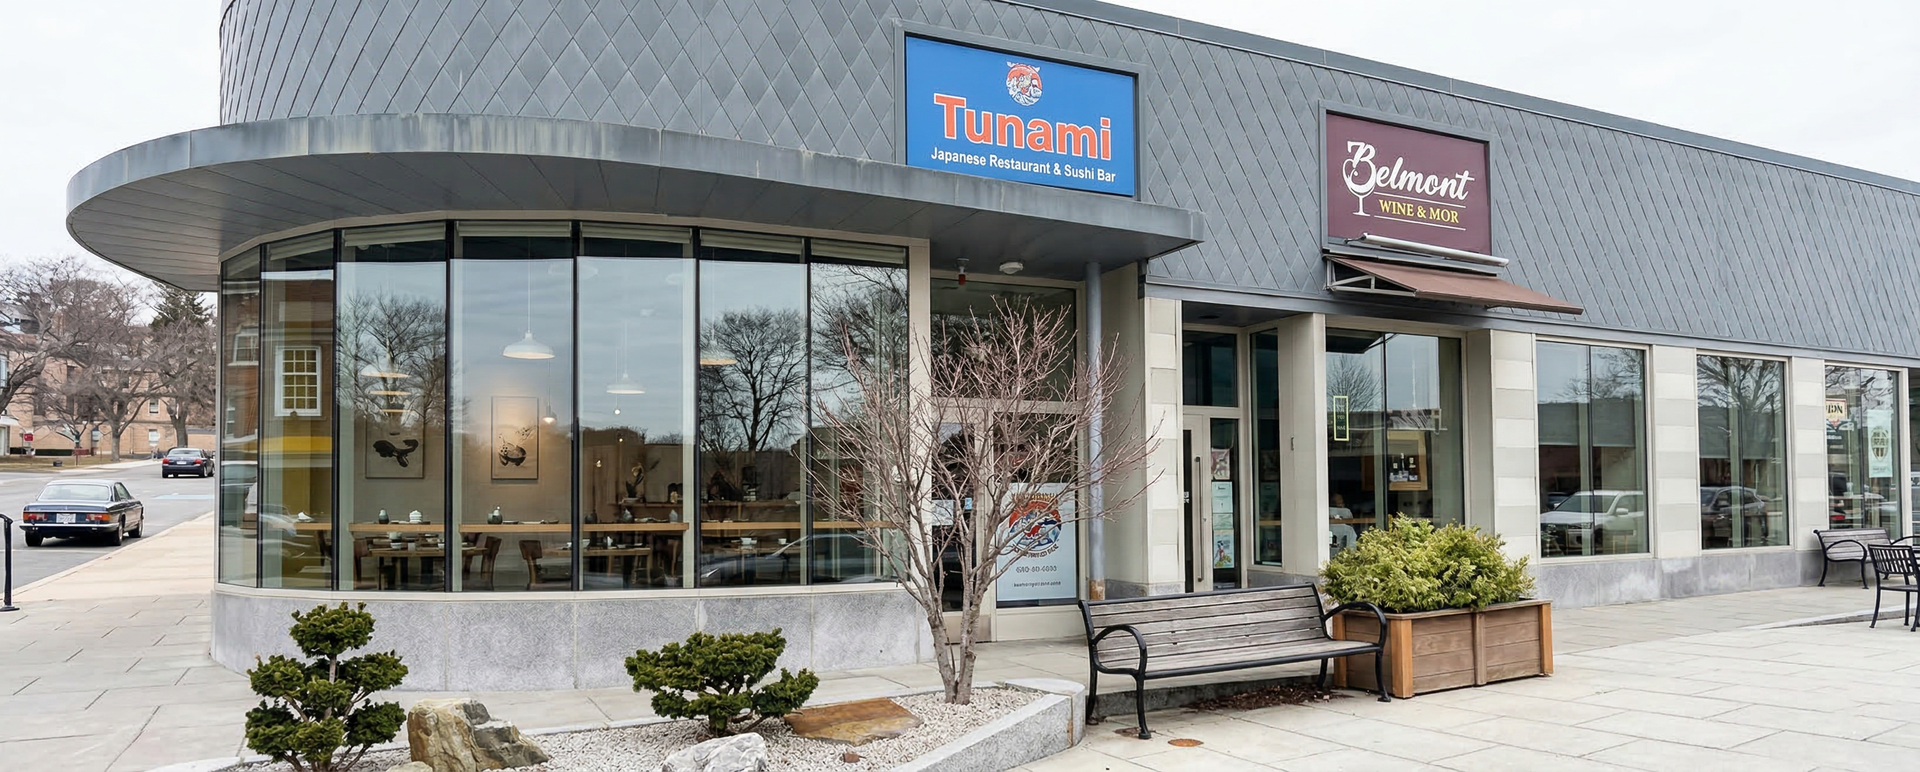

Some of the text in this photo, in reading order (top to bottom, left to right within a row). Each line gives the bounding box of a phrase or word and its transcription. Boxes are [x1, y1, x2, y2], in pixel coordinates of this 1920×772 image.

[933, 93, 1111, 160] Tunami
[931, 147, 1116, 182] Japanese Restaurant & Sushi Bar
[1342, 141, 1475, 200] Belmont
[1379, 200, 1459, 223] WINE & MOR
